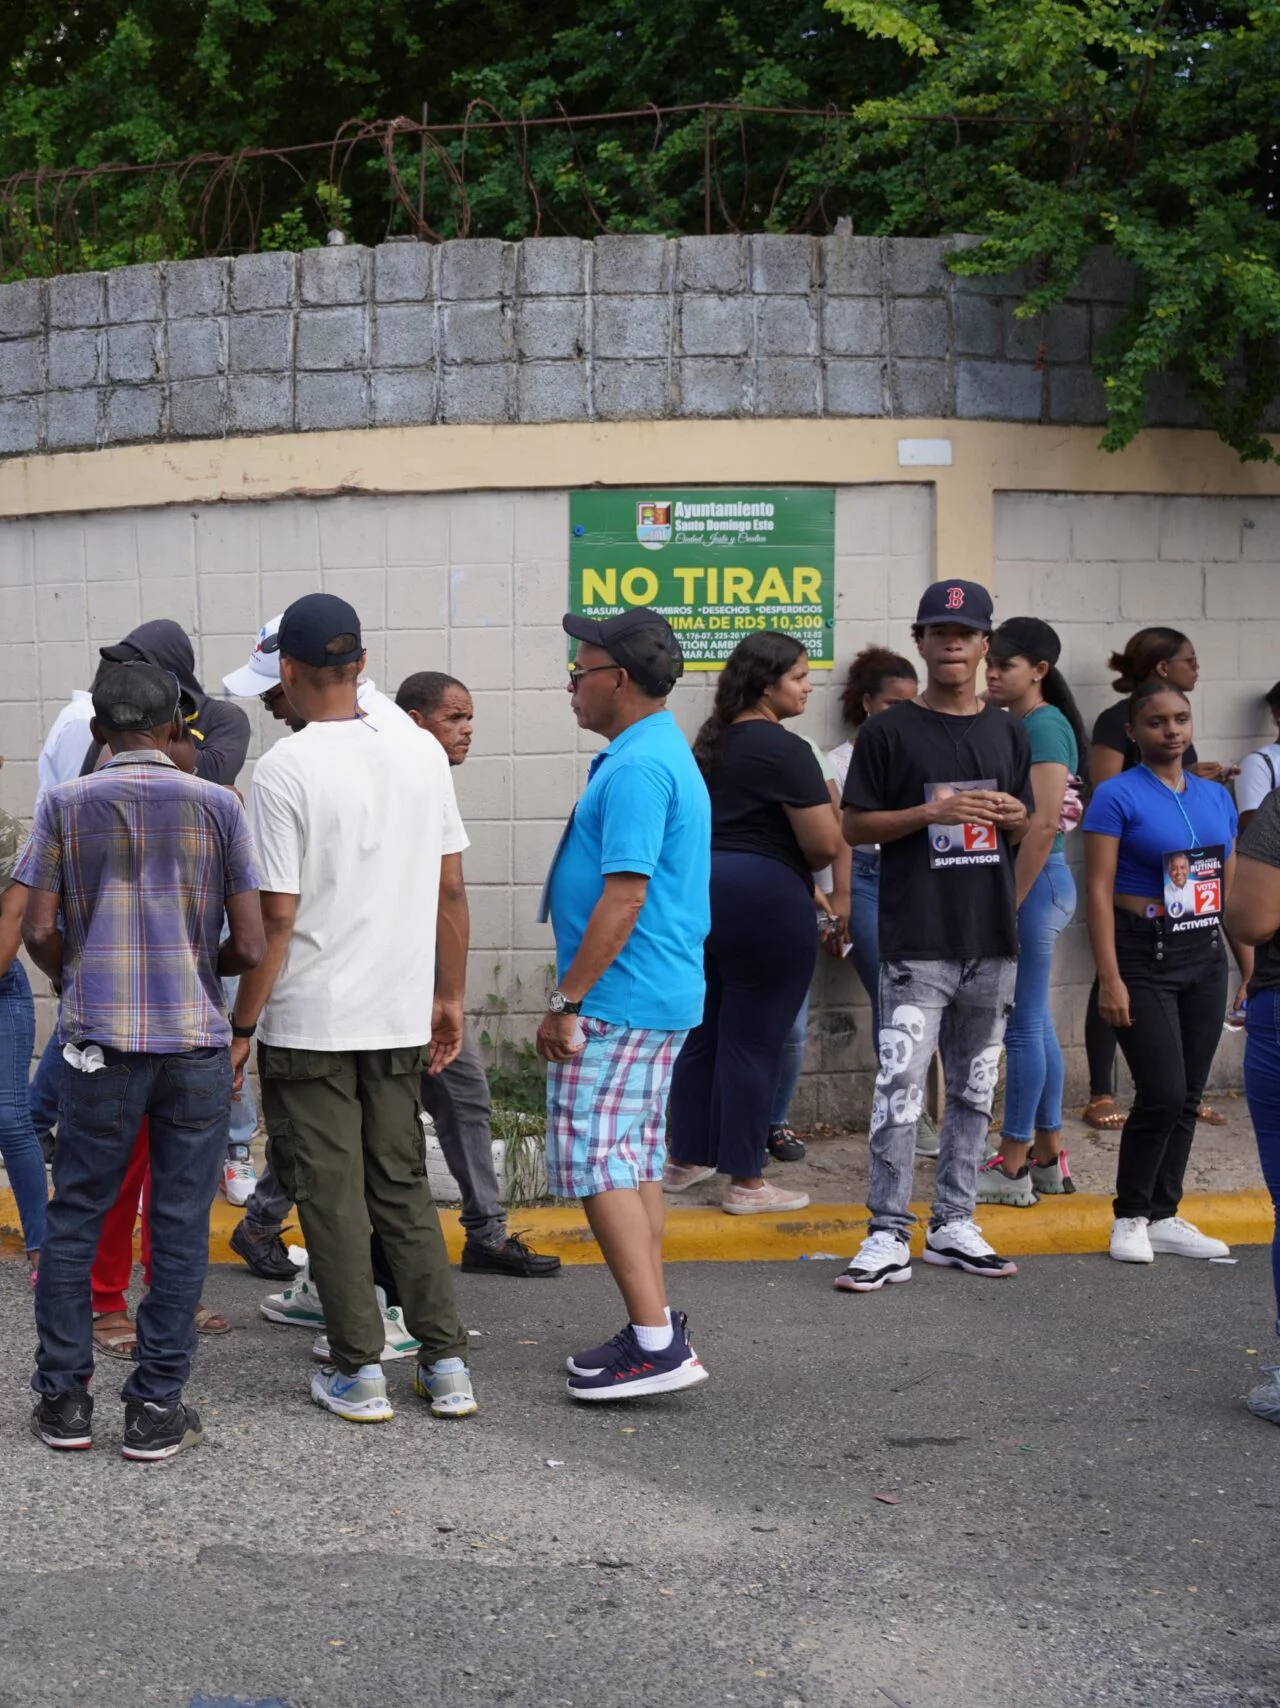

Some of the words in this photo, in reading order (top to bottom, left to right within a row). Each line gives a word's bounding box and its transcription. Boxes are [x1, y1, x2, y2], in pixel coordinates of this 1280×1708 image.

[674, 501, 775, 519] Ayuntamiento
[675, 520, 705, 531] Santo
[706, 519, 752, 532] Domingo
[753, 519, 774, 531] Este
[582, 567, 659, 605] NO
[673, 567, 822, 605] TIRAR
[945, 587, 964, 609] B
[586, 606, 625, 615] BASURA
[702, 606, 750, 615] DESECHOS
[758, 605, 823, 614] DESPERDICIOS
[709, 616, 730, 629] DE
[734, 615, 766, 630] RD$
[771, 615, 823, 630] 10,300
[971, 826, 990, 849] 2
[934, 854, 1000, 867] SUPERVISOR
[1197, 882, 1217, 892] VOTA
[1200, 890, 1216, 912] 2
[1172, 916, 1220, 932] ACTIVISTA
